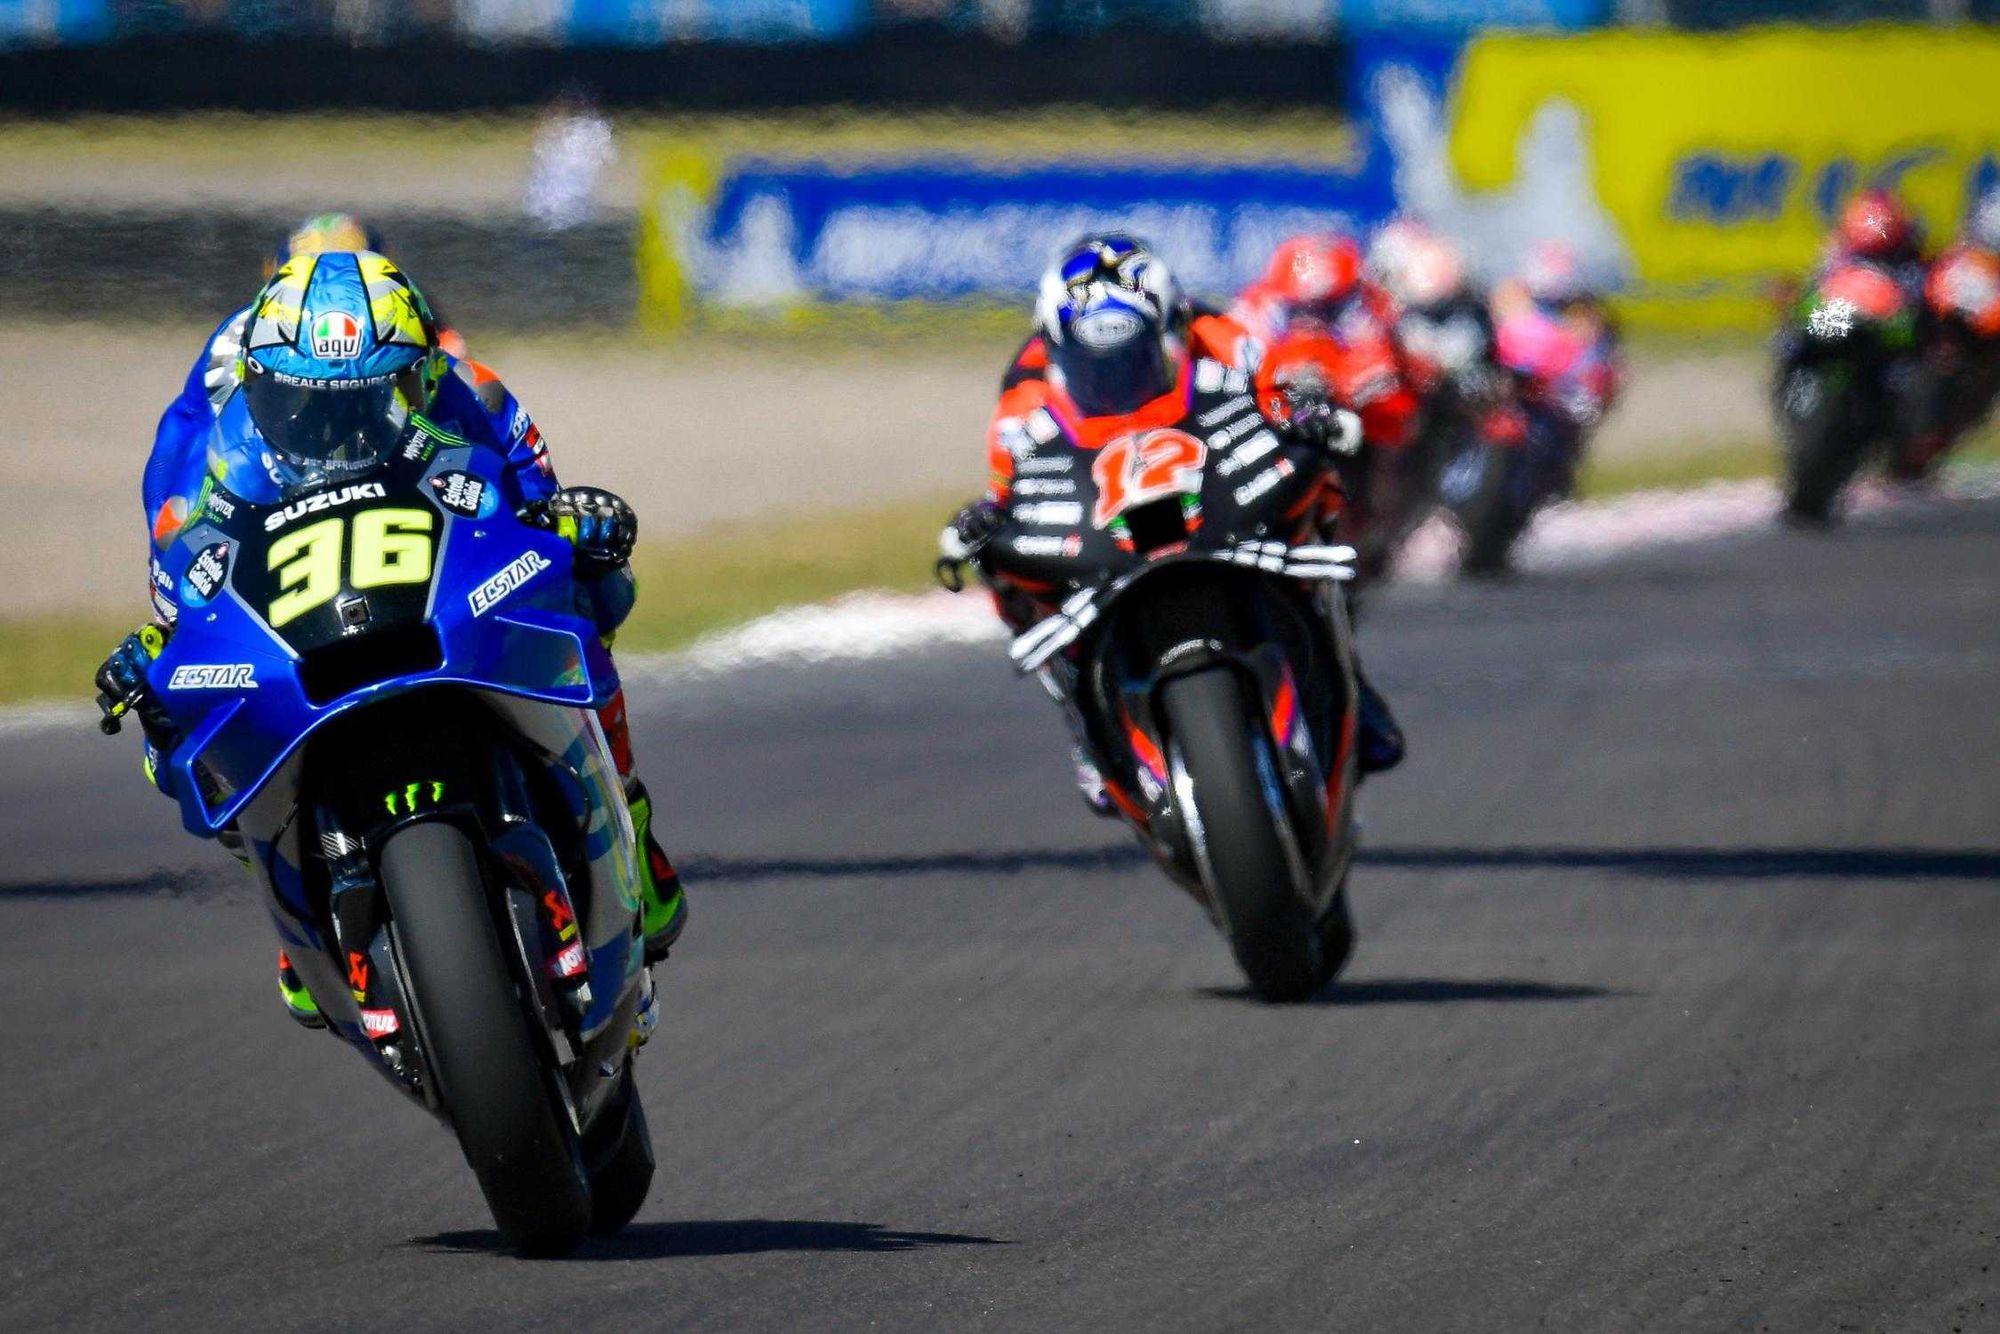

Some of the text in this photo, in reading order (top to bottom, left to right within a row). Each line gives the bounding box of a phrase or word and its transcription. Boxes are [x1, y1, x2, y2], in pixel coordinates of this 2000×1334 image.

[318, 337, 355, 357] agv
[283, 373, 327, 390] REALE
[1090, 428, 1208, 530] 12
[263, 482, 387, 532] SUZUKI
[267, 507, 433, 628] 36
[467, 550, 552, 618] ECSTAR
[167, 663, 260, 690] ECSTAR
